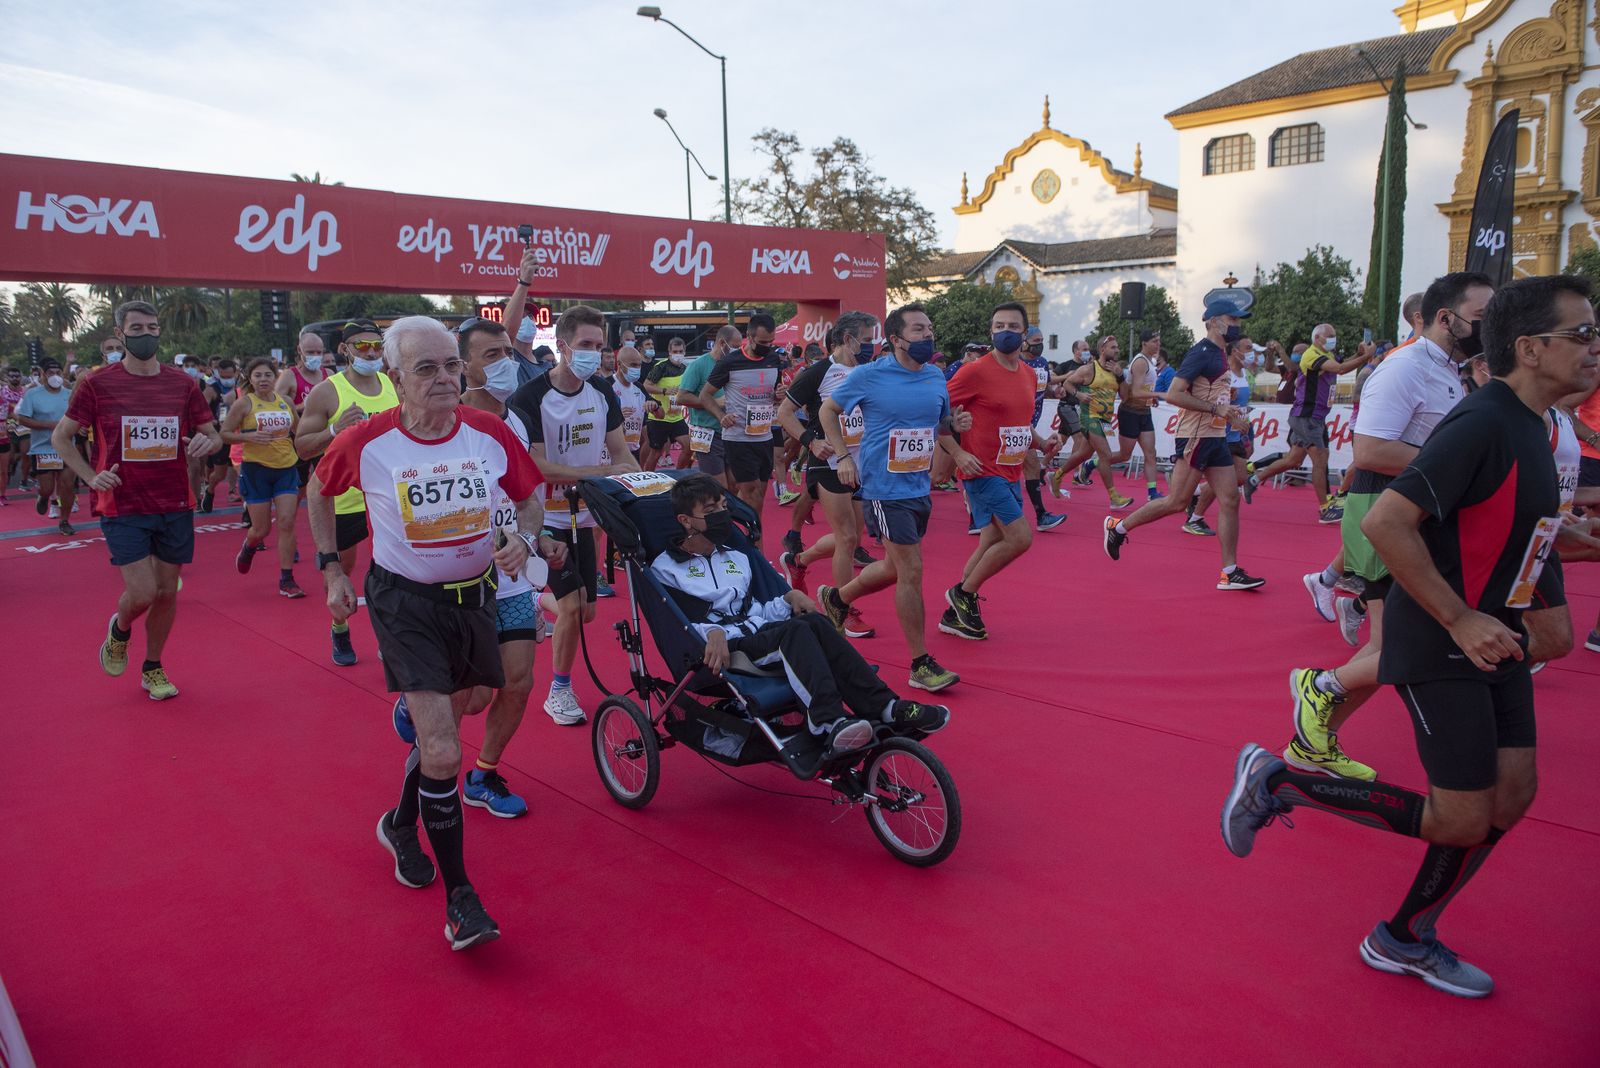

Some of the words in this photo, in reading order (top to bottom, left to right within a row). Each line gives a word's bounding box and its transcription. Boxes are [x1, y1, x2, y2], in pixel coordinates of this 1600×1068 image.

[15, 191, 160, 238] HOKA
[234, 194, 342, 272] edp
[397, 218, 453, 263] edp
[524, 242, 593, 265] evilla
[650, 228, 715, 288] edp
[751, 248, 811, 275] HOKA
[460, 264, 474, 274] 17
[478, 265, 521, 276] octubr
[129, 426, 170, 440] 4518
[1006, 435, 1028, 448] 3931
[1251, 411, 1280, 447] dp
[1325, 414, 1353, 451] dp
[899, 439, 924, 452] 765
[401, 468, 418, 479] edp
[433, 464, 449, 475] edp
[407, 477, 474, 507] 6573
